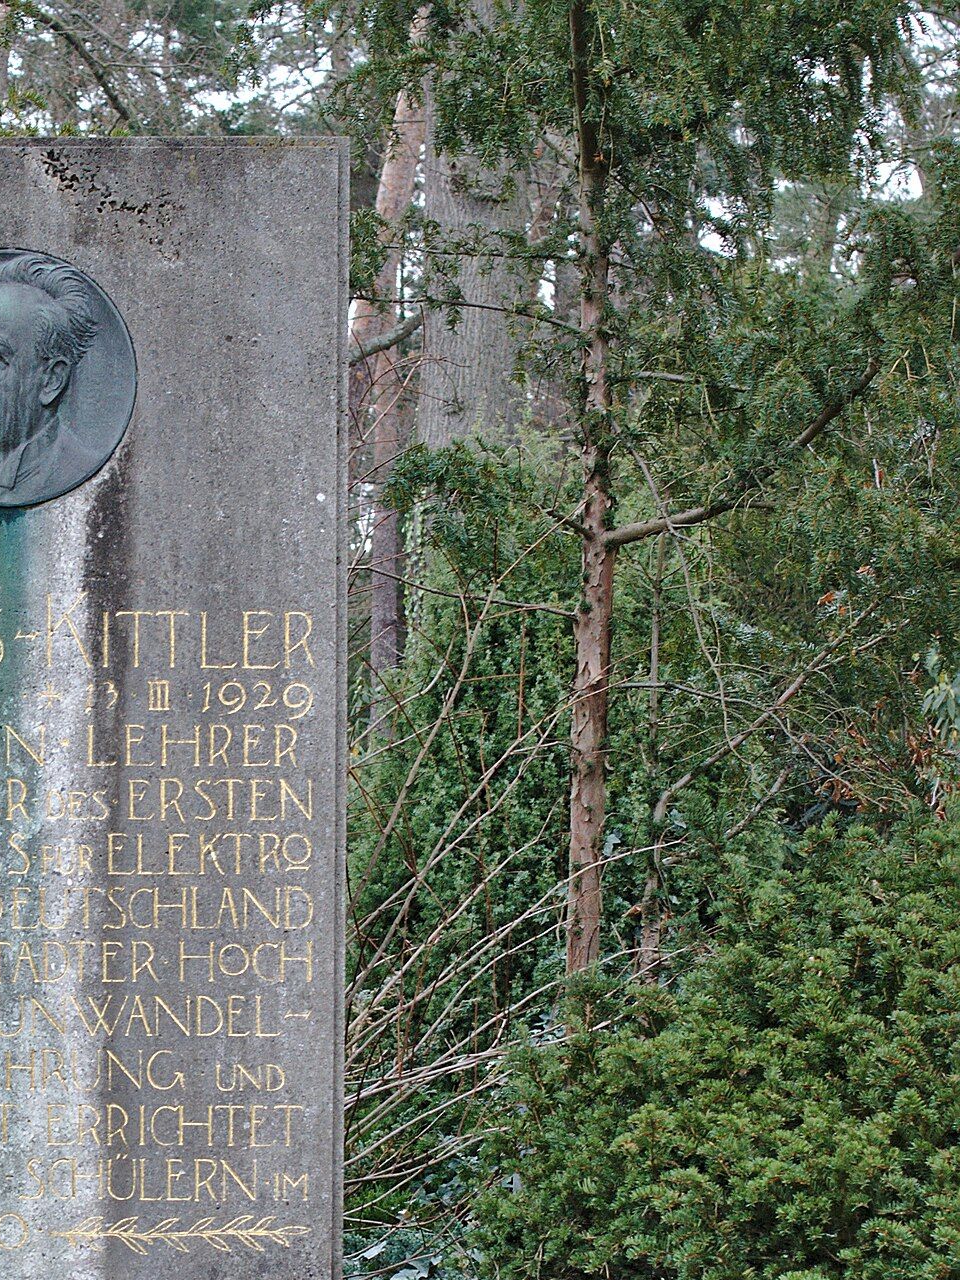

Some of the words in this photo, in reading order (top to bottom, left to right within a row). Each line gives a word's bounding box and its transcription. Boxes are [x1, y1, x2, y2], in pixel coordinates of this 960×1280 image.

[44, 590, 315, 669] KITTLER
[202, 679, 315, 720] 1929
[86, 724, 299, 767] LEHRER
[128, 778, 313, 821] ERSTEN
[108, 833, 313, 876] ELEKTRO
[179, 941, 314, 984] HOCH
[215, 1063, 285, 1093] UND
[47, 1104, 303, 1148] ERRICHTET
[19, 1154, 258, 1202] SCHÜLERN
[273, 1174, 309, 1201] IM
